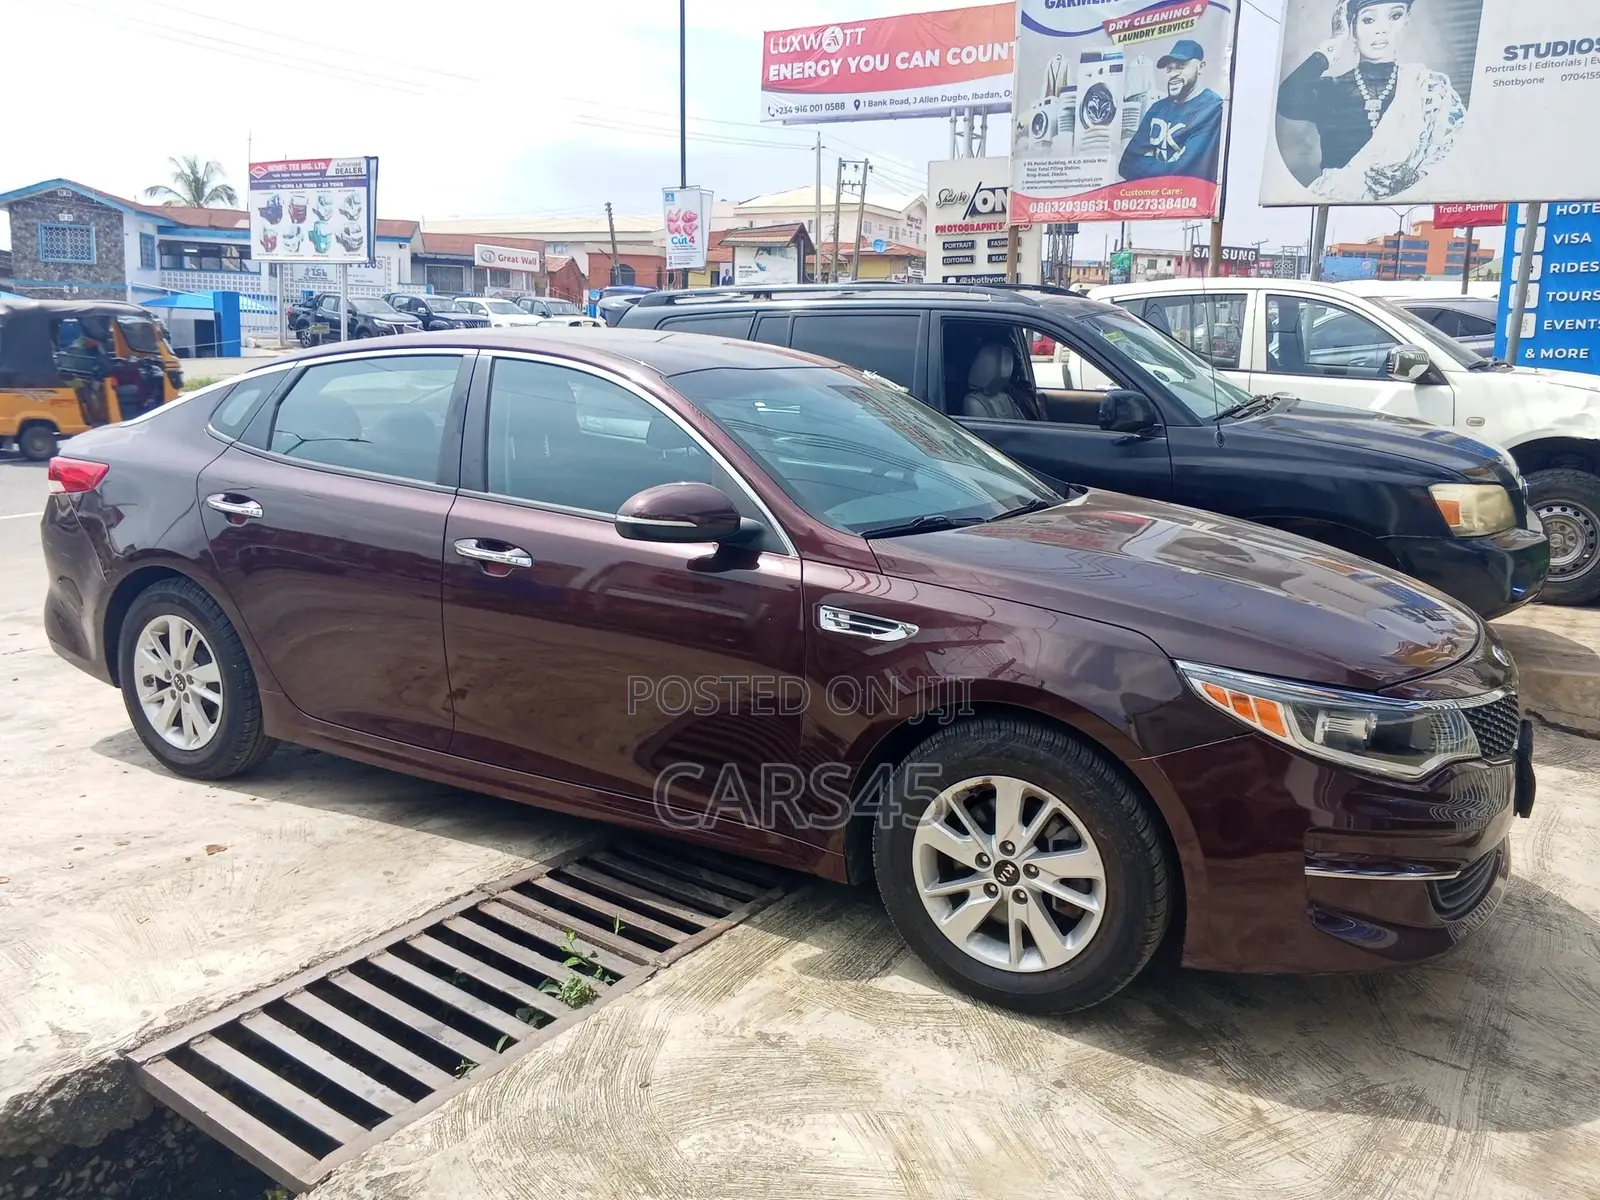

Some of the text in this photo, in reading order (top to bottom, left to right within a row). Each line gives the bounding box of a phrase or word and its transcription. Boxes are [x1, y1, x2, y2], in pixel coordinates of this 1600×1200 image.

[1108, 4, 1203, 32] DRY CLEANING &
[1117, 19, 1195, 43] LAUNDRY SERVICES
[768, 41, 1016, 82] ENERGY YOU CAN COUNT
[1485, 62, 1527, 74] Portraits
[1535, 58, 1582, 70] Editorials
[1492, 77, 1545, 88] Shotbyone
[795, 105, 808, 114] 916
[809, 104, 823, 112] 001
[824, 102, 846, 111] 0588
[868, 99, 887, 108] Bank
[889, 97, 911, 106] Road,
[918, 95, 939, 104] Allen
[941, 94, 970, 104] Dugbe,
[971, 91, 1002, 100] Ibadan,
[335, 167, 363, 175] DEALER
[1119, 187, 1183, 197] Customer Care:
[1439, 203, 1498, 214] Trade Partner
[1556, 203, 1600, 216] HOTE
[935, 222, 997, 233] PHOTOGRAPHY
[688, 235, 695, 244] 4
[1553, 232, 1592, 245] VISA
[944, 241, 973, 249] PORTRAIT
[498, 254, 537, 266] Great Wall
[943, 256, 972, 264] EDITORIAL
[1193, 247, 1256, 261] SASUNG
[1549, 261, 1600, 274] RIDES
[1546, 290, 1600, 302] TOURS
[1525, 348, 1589, 359] & MORE
[997, 863, 1016, 883] KIA
